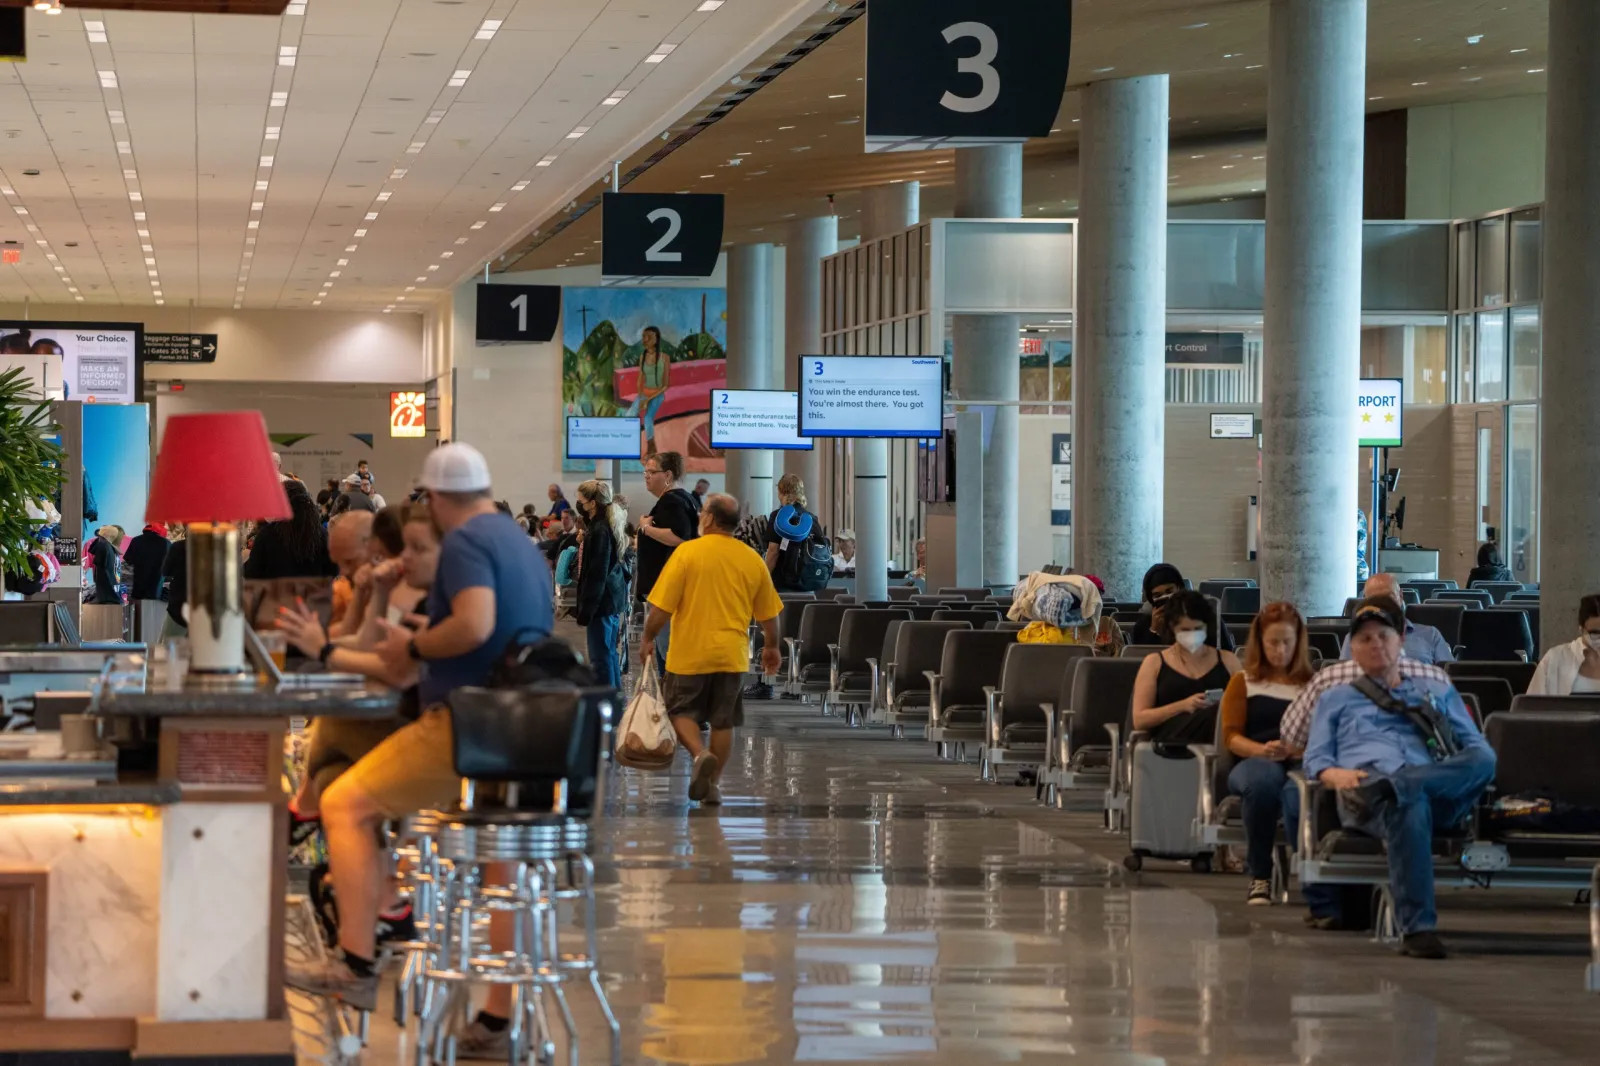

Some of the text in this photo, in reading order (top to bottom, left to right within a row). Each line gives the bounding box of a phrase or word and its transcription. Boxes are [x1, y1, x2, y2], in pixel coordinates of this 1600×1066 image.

[939, 21, 1000, 113] 3
[645, 207, 682, 262] 2
[510, 294, 527, 332] 1
[76, 334, 128, 343] Your Choice.
[1024, 339, 1041, 354] EXIT
[1174, 343, 1207, 352] Control
[814, 361, 824, 376] 3
[808, 388, 920, 397] You win the endurance test.
[721, 393, 729, 404] 2
[1358, 395, 1396, 407] RPORT
[808, 400, 924, 410] You're almost there. You got
[808, 411, 826, 419] this.
